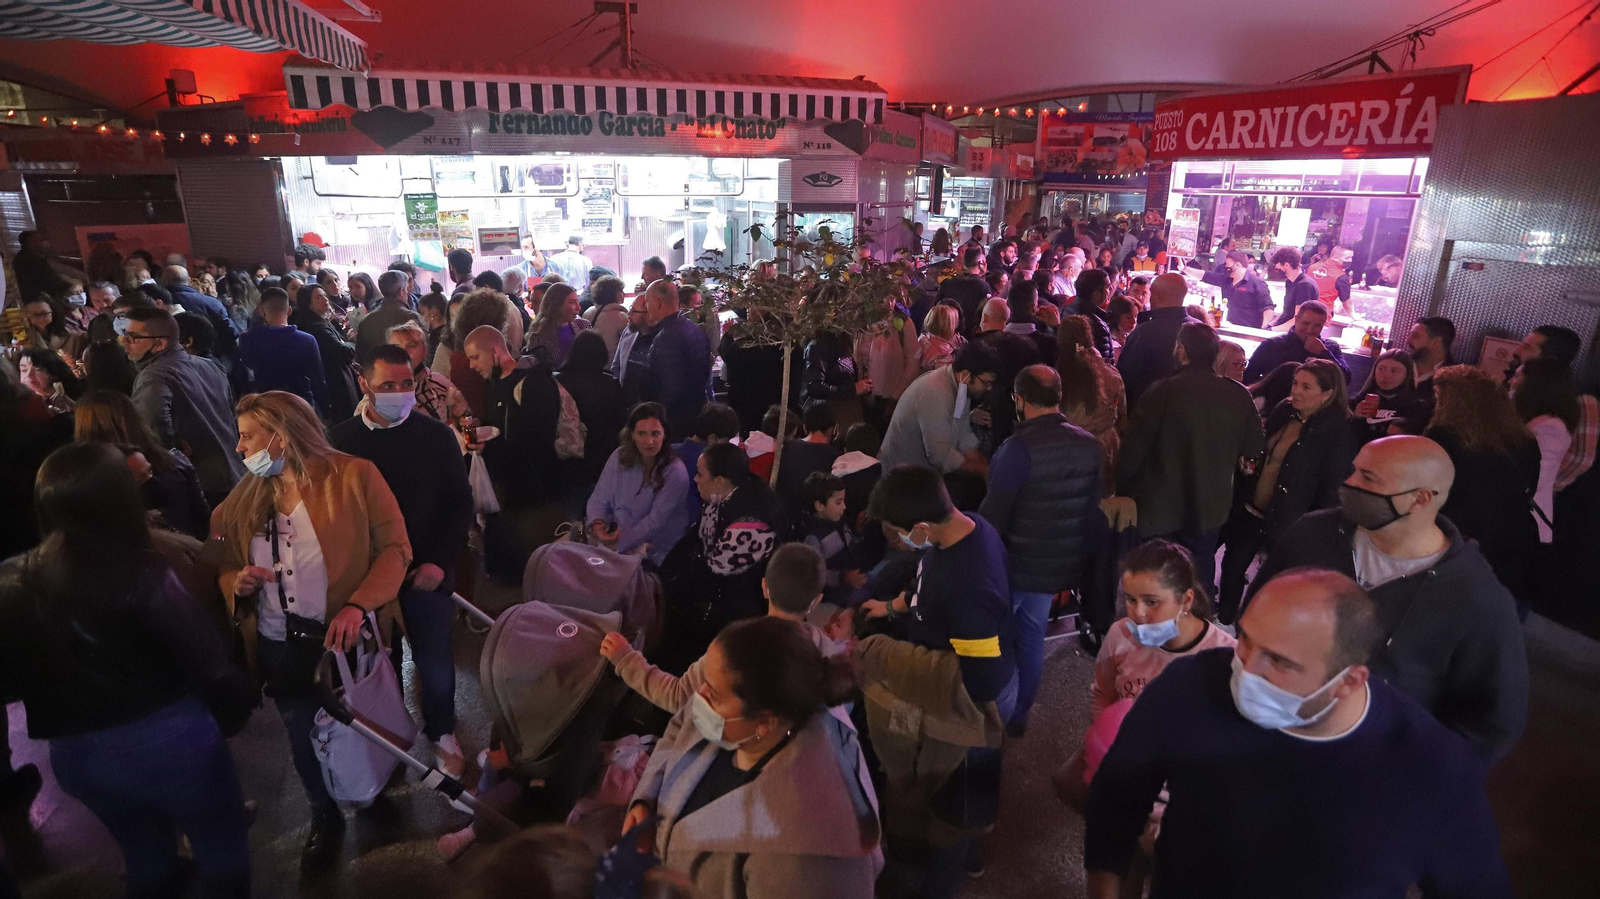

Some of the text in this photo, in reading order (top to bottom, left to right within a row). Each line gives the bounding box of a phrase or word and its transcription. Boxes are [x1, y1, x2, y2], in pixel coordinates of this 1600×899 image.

[1153, 109, 1184, 131] PUESTO
[1185, 82, 1439, 151] CARNICERÍA
[816, 142, 832, 150] 118
[1154, 131, 1178, 153] 108
[971, 152, 984, 161] 83
[1376, 409, 1397, 418] NIKE
